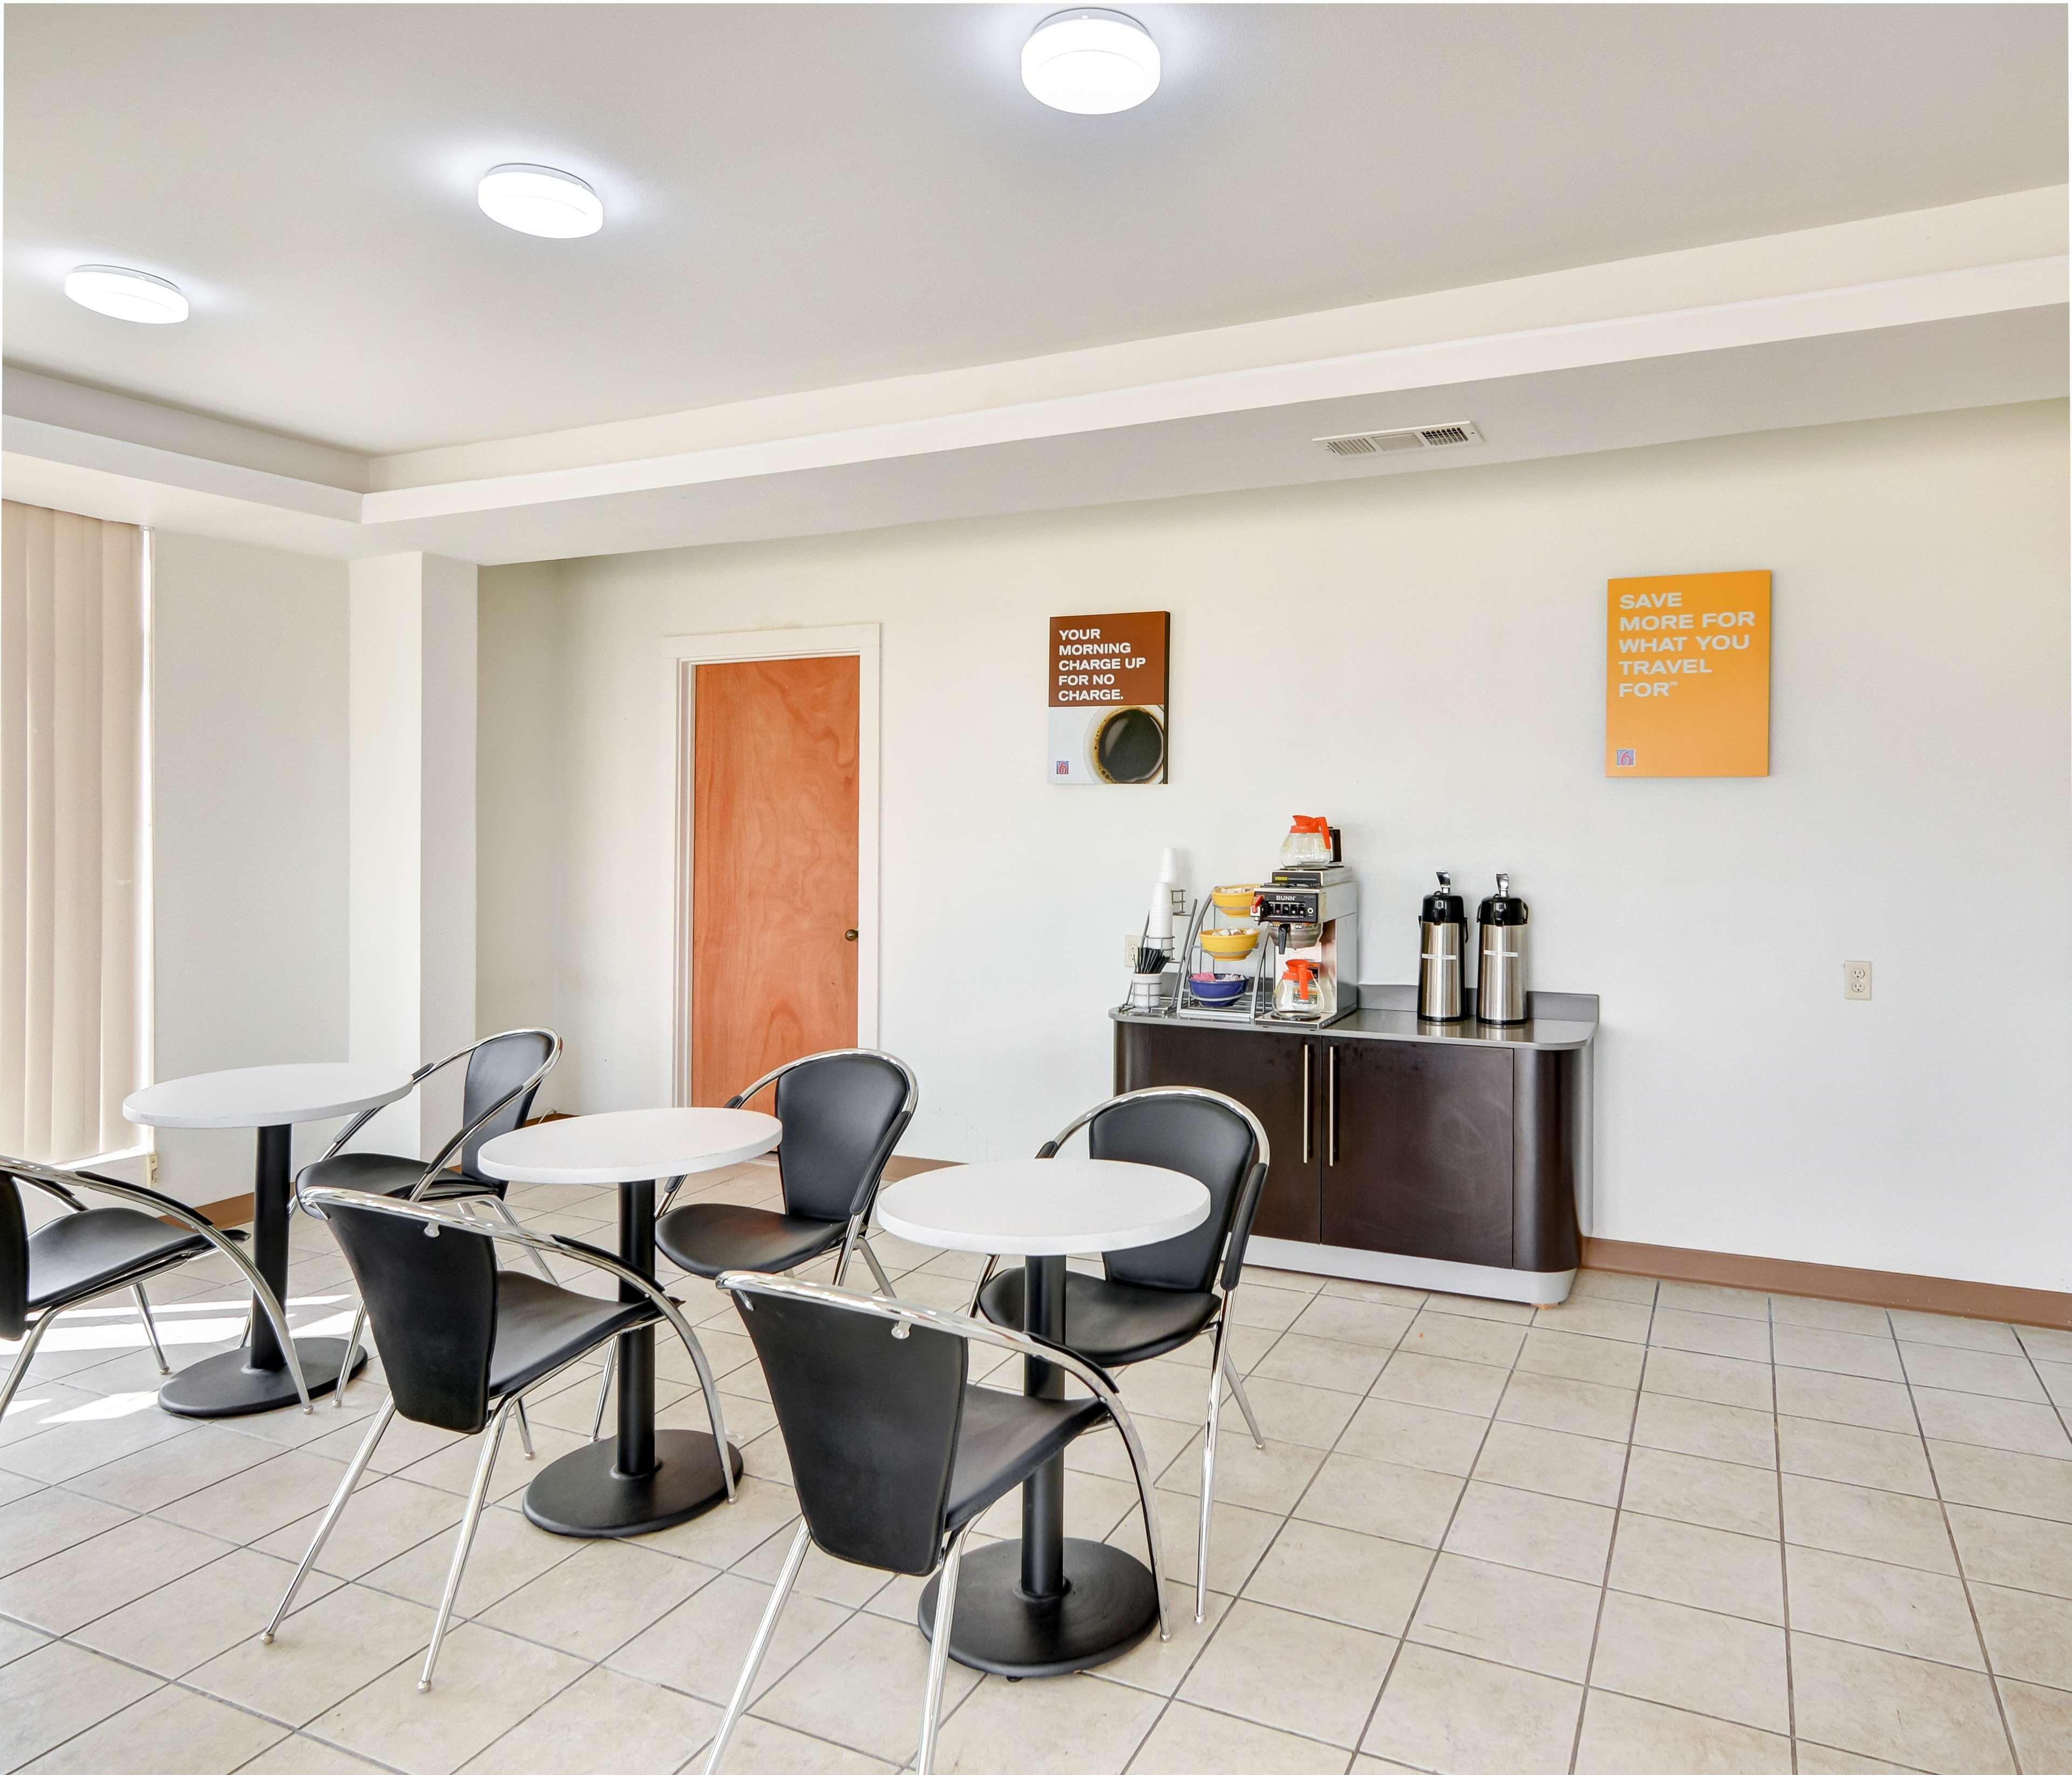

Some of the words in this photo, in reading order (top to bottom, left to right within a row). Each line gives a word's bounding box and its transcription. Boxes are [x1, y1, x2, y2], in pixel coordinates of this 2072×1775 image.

[1620, 593, 1682, 609] SAVE
[1620, 614, 1694, 631] MORE
[1702, 611, 1755, 628] FOR
[1058, 628, 1100, 641] YOUR
[1059, 642, 1131, 656] MORNING
[1619, 636, 1688, 653] WHAT
[1695, 634, 1750, 650] YOU
[1058, 658, 1121, 671] CHARGE
[1125, 657, 1146, 669] UP
[1619, 659, 1713, 675] TRAVEL
[1058, 675, 1089, 686] FOR
[1092, 674, 1115, 685] NO
[1058, 689, 1124, 702] CHARGE.
